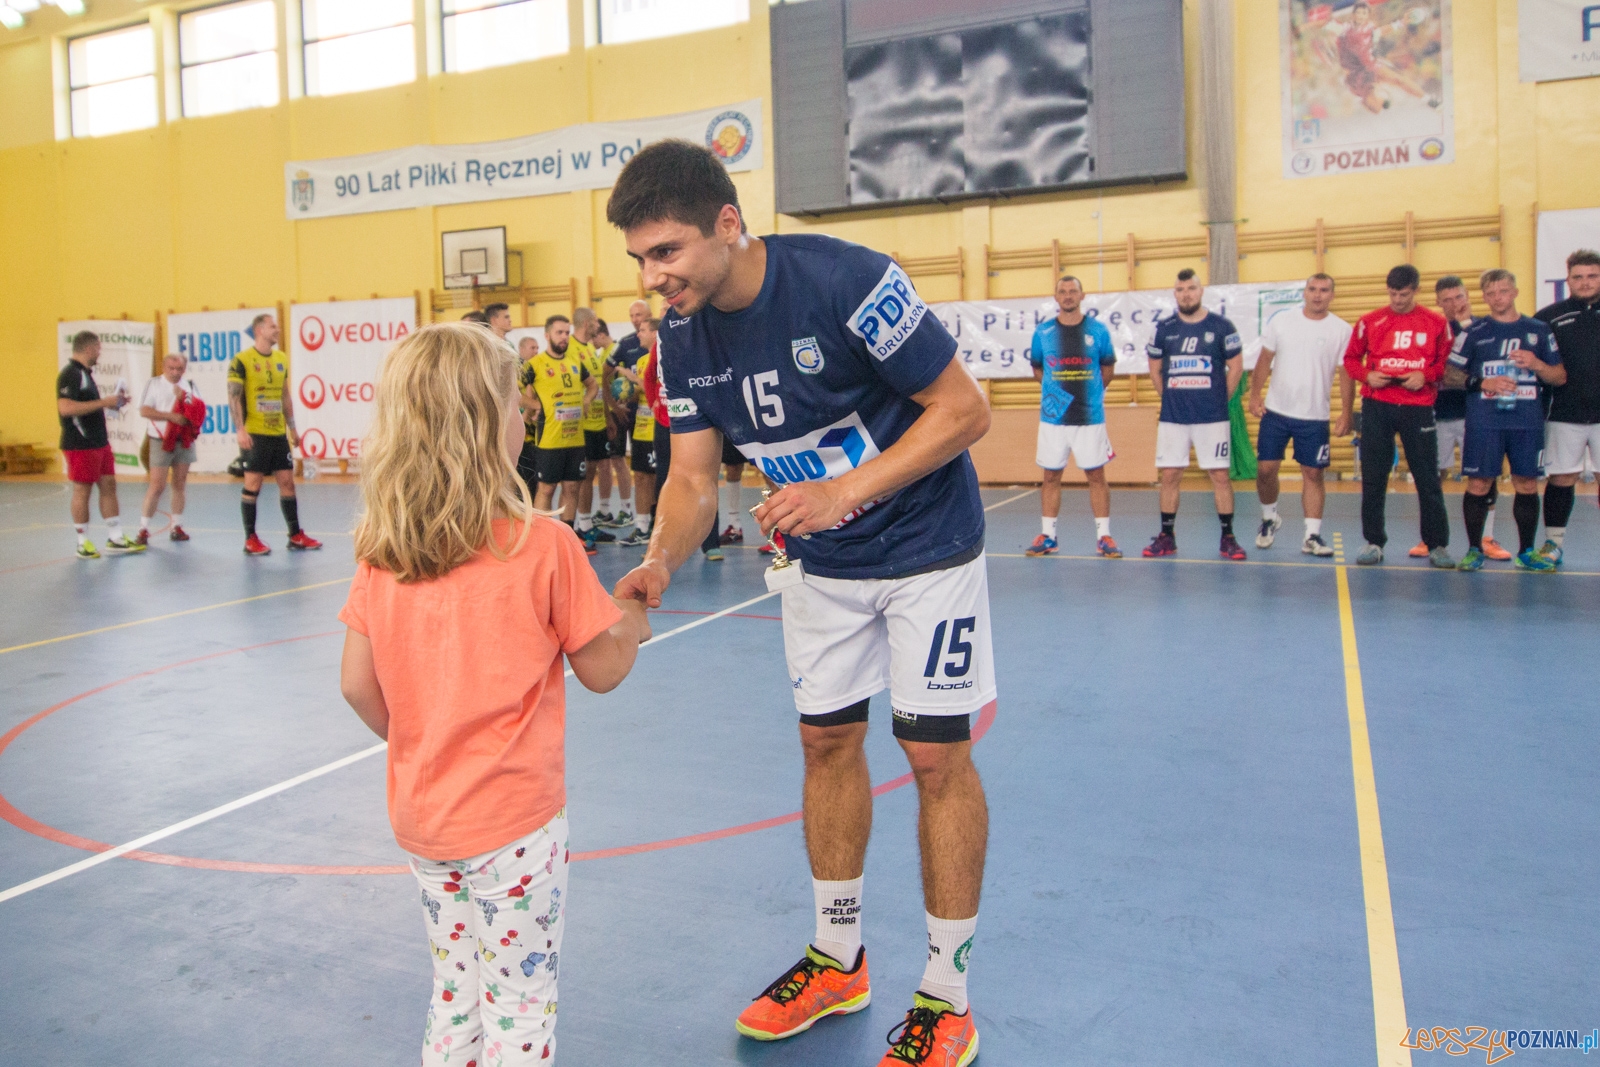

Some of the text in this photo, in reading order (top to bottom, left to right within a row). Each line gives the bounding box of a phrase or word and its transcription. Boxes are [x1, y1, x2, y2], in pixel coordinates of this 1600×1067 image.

[1323, 140, 1410, 171] POZNAŃ
[335, 175, 360, 197] 90
[368, 168, 401, 194] Lat
[409, 161, 457, 188] Piłki
[465, 149, 562, 187] Ręcznej
[571, 151, 592, 170] w
[858, 279, 911, 348] PDP
[330, 321, 409, 343] VEOLIA
[1181, 336, 1198, 353] 18
[1393, 330, 1413, 350] 16
[177, 331, 241, 363] ELBUD
[330, 382, 375, 403] VEO
[742, 369, 785, 430] 15
[1214, 442, 1228, 458] 18
[761, 450, 827, 484] BUD
[924, 616, 976, 678] 15
[834, 897, 856, 907] AZS
[831, 916, 856, 925] GÓRA
